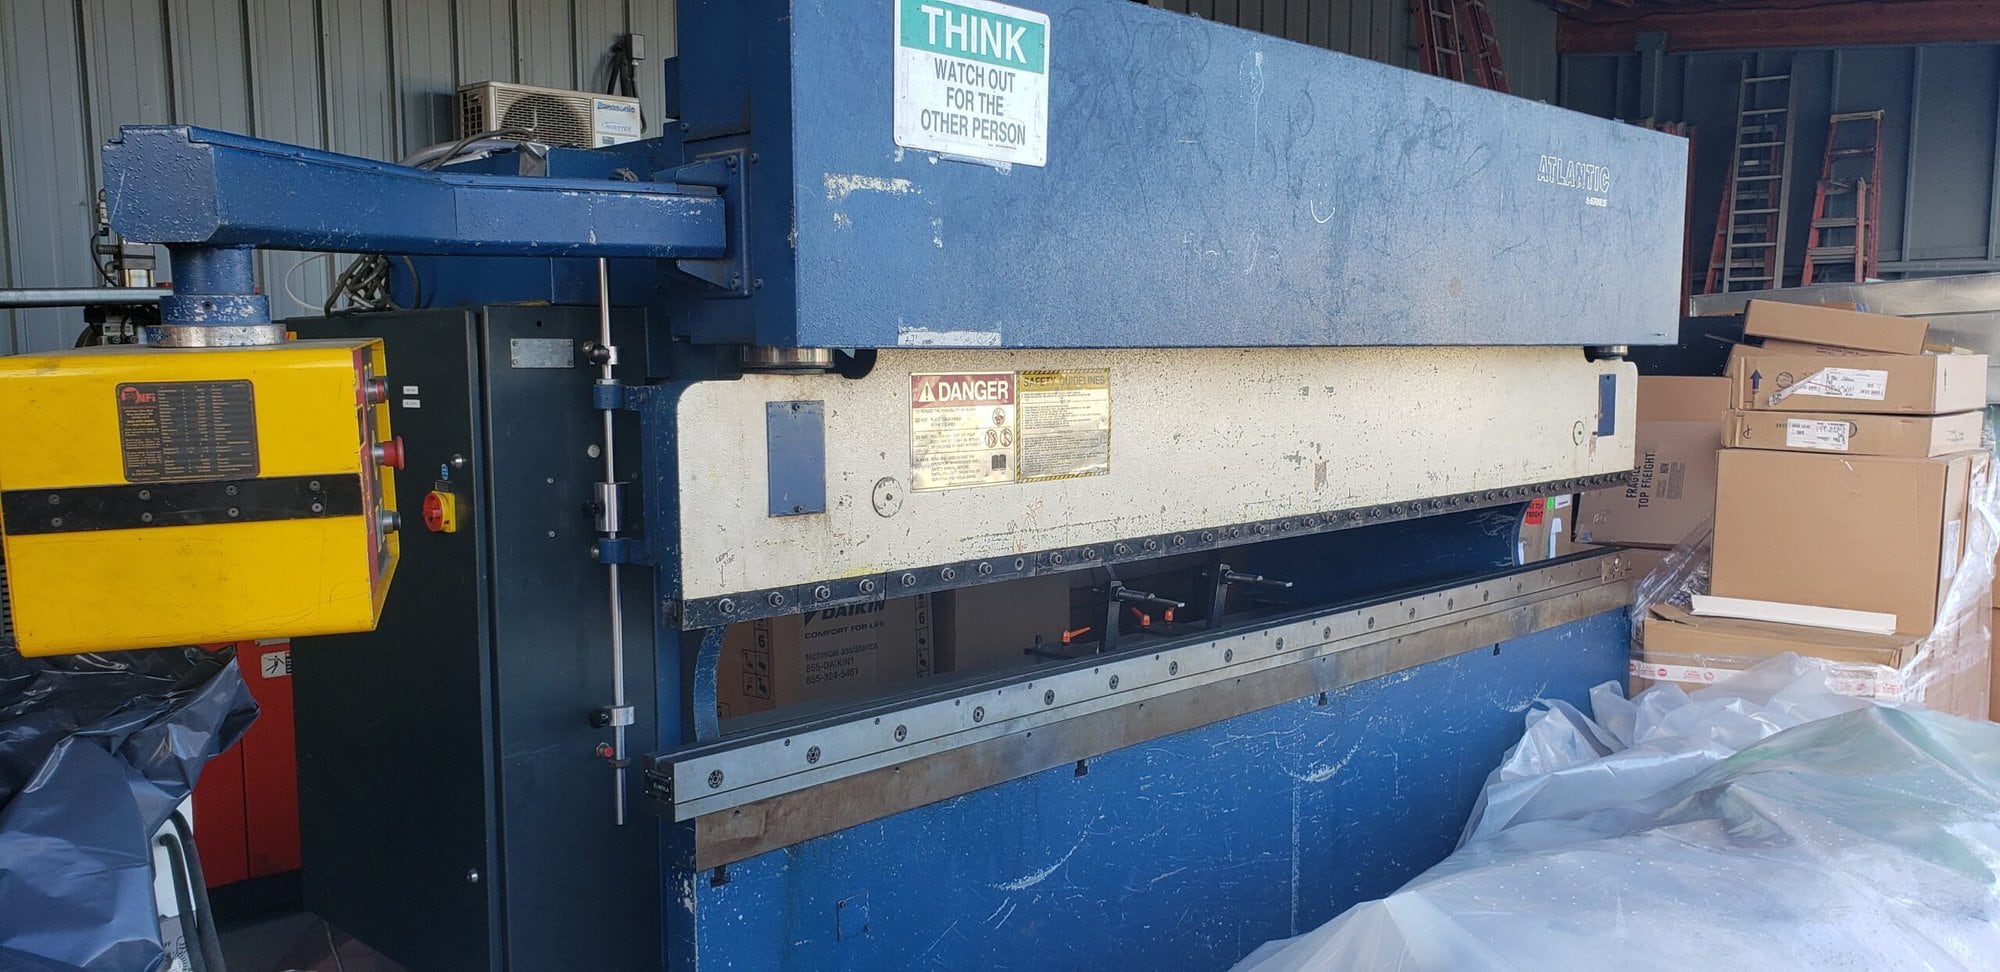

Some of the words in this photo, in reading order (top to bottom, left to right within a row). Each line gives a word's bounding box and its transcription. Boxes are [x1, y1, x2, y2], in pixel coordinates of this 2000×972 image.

[921, 4, 1027, 64] THINK
[934, 57, 985, 87] WATCH
[989, 69, 1016, 93] OUT
[946, 86, 974, 112] FOR
[978, 92, 1004, 117] THE
[921, 108, 968, 137] OTHER
[972, 117, 1026, 145] PERSON
[1537, 155, 1610, 193] ATLANTIC
[938, 380, 1009, 402] DANGER
[1023, 376, 1057, 388] SAFETY
[1060, 375, 1105, 386] GUIDELINES
[1641, 452, 1655, 488] FREIGHT
[1638, 492, 1649, 508] TOP
[821, 600, 885, 620] DAIKIN
[919, 612, 925, 624] 6
[804, 626, 849, 640] COMFORT
[850, 623, 867, 632] FOR
[869, 620, 884, 629] LIFE
[758, 635, 766, 649] 6
[805, 648, 839, 661] technical
[840, 642, 879, 655] assistance
